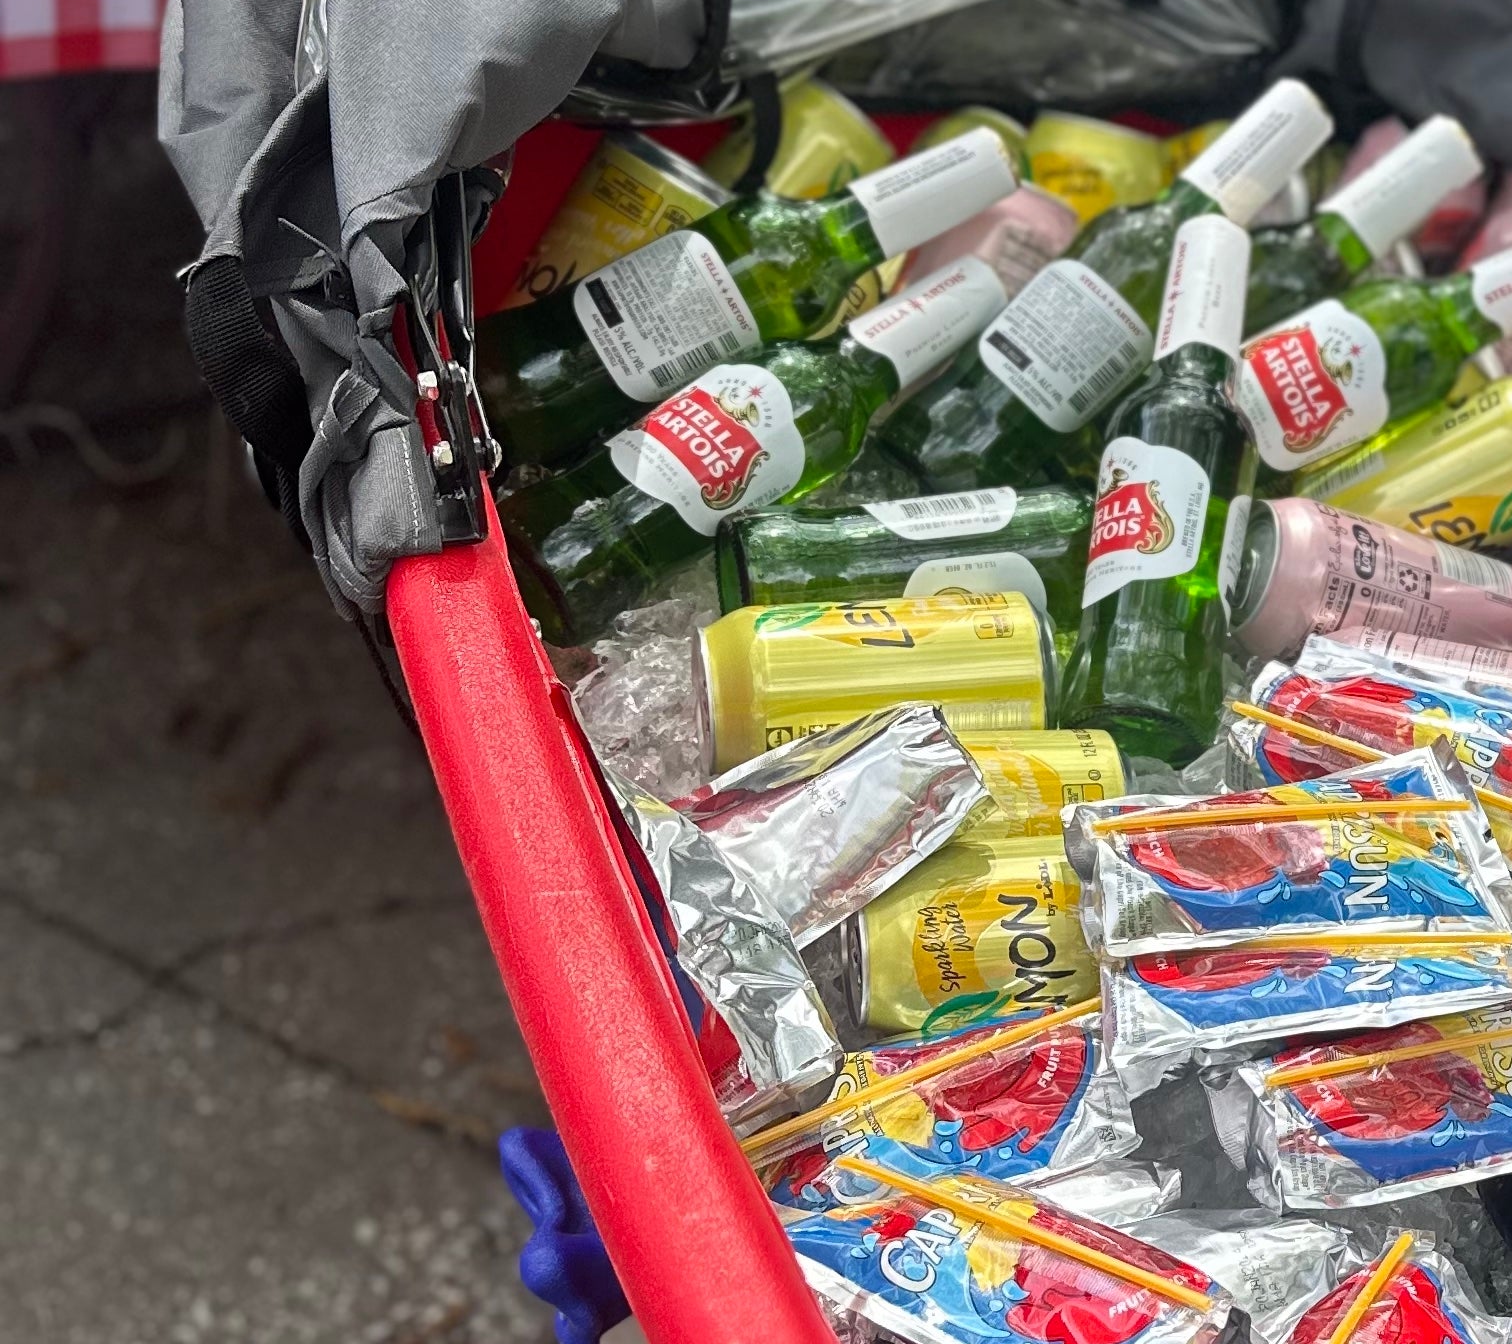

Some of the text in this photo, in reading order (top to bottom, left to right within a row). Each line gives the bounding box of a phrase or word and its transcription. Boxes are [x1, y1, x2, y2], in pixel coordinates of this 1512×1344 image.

[699, 251, 751, 333] STELLA ARTOIS
[864, 271, 966, 340] STELLA ARTOIS
[1078, 272, 1144, 338] STELLA ARTOIS
[1160, 241, 1187, 350] STELLA ARTOIS
[1263, 348, 1315, 428] ARTOIS
[1282, 337, 1331, 419] STELLA
[653, 411, 731, 479] ARTOIS
[673, 398, 744, 467] STELLA
[948, 900, 976, 955] Water
[1045, 902, 1057, 920] by
[923, 903, 961, 993] Sparkling
[1037, 1049, 1061, 1087] FRUIT
[1109, 1288, 1151, 1320] FRUIT
